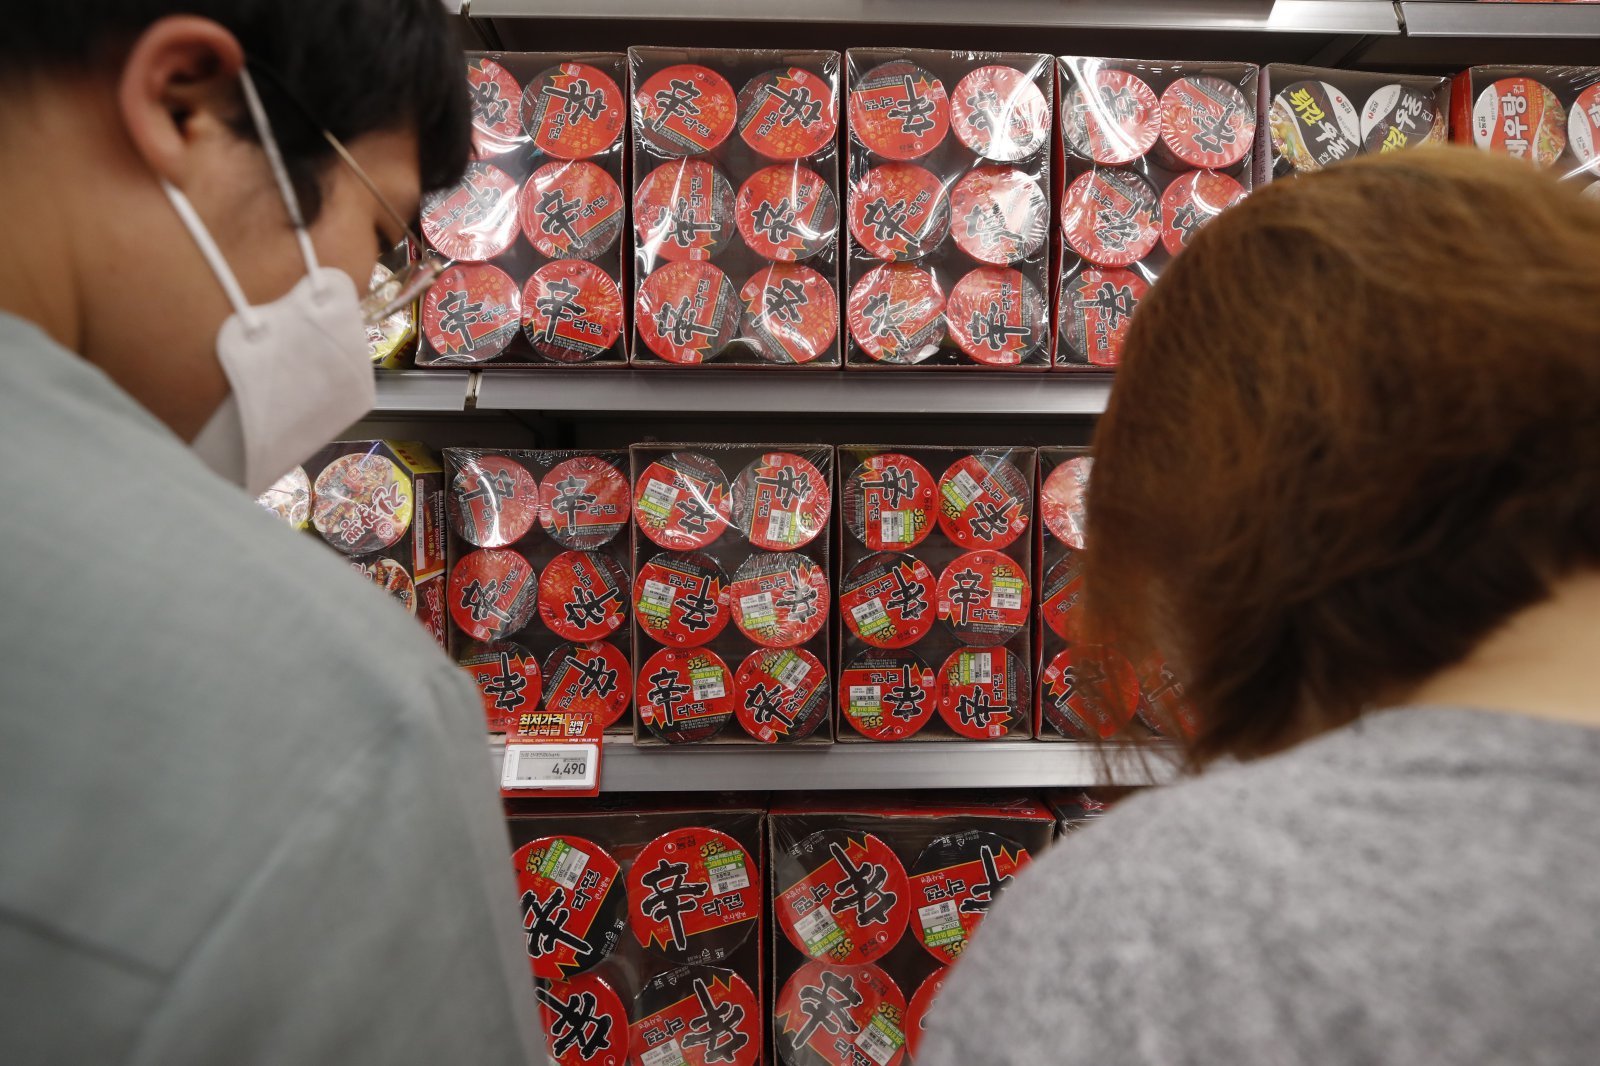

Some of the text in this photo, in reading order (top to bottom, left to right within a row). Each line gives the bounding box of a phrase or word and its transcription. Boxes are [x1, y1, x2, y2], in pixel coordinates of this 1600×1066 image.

[543, 79, 607, 125] 辛
[652, 79, 701, 132] 辛
[756, 111, 779, 136] 라면
[765, 84, 822, 127] 辛
[864, 97, 895, 110] 라면
[887, 74, 936, 137] 辛
[1421, 110, 1433, 121] 컵
[548, 113, 565, 140] 라면
[682, 115, 711, 137] 라면
[1192, 101, 1237, 154] 辛
[1289, 88, 1349, 160] 튀김우동
[1502, 93, 1528, 157] 새우탕
[580, 196, 609, 218] 라면
[691, 178, 703, 207] 라면
[907, 190, 930, 216] 라면
[534, 189, 583, 249] 辛
[751, 197, 807, 244] 辛
[863, 197, 920, 246] 辛
[1095, 198, 1144, 252] 辛
[480, 304, 508, 323] 라면
[537, 278, 585, 343] 辛
[695, 279, 710, 308] 라면
[751, 278, 808, 327] 辛
[1001, 283, 1013, 312] 라면
[1075, 282, 1139, 329] 辛
[437, 290, 483, 350] 辛
[573, 320, 602, 335] 라면
[654, 296, 719, 346] 辛
[862, 292, 911, 351] 辛
[967, 301, 1031, 351] 辛
[1095, 322, 1110, 350] 라면
[459, 469, 516, 512] 辛
[552, 475, 597, 535] 辛
[675, 481, 717, 534] 辛
[755, 466, 812, 509] 辛
[759, 490, 771, 518] 라면
[861, 466, 919, 509] 辛
[868, 493, 880, 521] 라면
[980, 477, 1003, 502] 라면
[341, 482, 407, 543] 진짬뽕
[588, 504, 616, 516] 라면
[969, 497, 1018, 541] 辛
[499, 569, 519, 595] 라면
[572, 562, 591, 588] 라면
[669, 573, 697, 590] 라면
[759, 577, 787, 591] 라면
[865, 579, 894, 598] 라면
[886, 566, 928, 620] 辛
[991, 567, 1005, 577] 35
[461, 579, 512, 622] 辛
[565, 586, 619, 629] 辛
[675, 575, 718, 632] 辛
[775, 565, 818, 623] 辛
[948, 568, 990, 626] 辛
[973, 609, 1000, 620] 라면
[484, 652, 527, 712] 辛
[565, 656, 618, 699] 辛
[687, 658, 702, 670] 35
[870, 671, 898, 684] 라면
[559, 683, 579, 709] 라면
[647, 667, 690, 727] 辛
[744, 682, 794, 728] 辛
[785, 687, 808, 712] 라면
[883, 664, 926, 722] 辛
[955, 686, 1011, 728] 辛
[993, 673, 1004, 701] 라면
[516, 725, 561, 737] 보상적립
[519, 713, 565, 725] 최저가격
[677, 703, 706, 716] 라면
[551, 763, 586, 775] 4,490
[526, 855, 541, 875] 35
[700, 845, 718, 857] 35
[572, 870, 600, 910] 라면
[641, 859, 708, 951] 辛
[702, 893, 744, 917] 라면
[791, 883, 830, 916] 라면
[829, 842, 897, 927] 辛
[924, 879, 966, 902] 라면
[520, 887, 593, 958] 辛
[534, 987, 613, 1060] 辛
[643, 1017, 685, 1046] 라면
[682, 978, 749, 1063] 辛
[792, 971, 863, 1050] 辛
